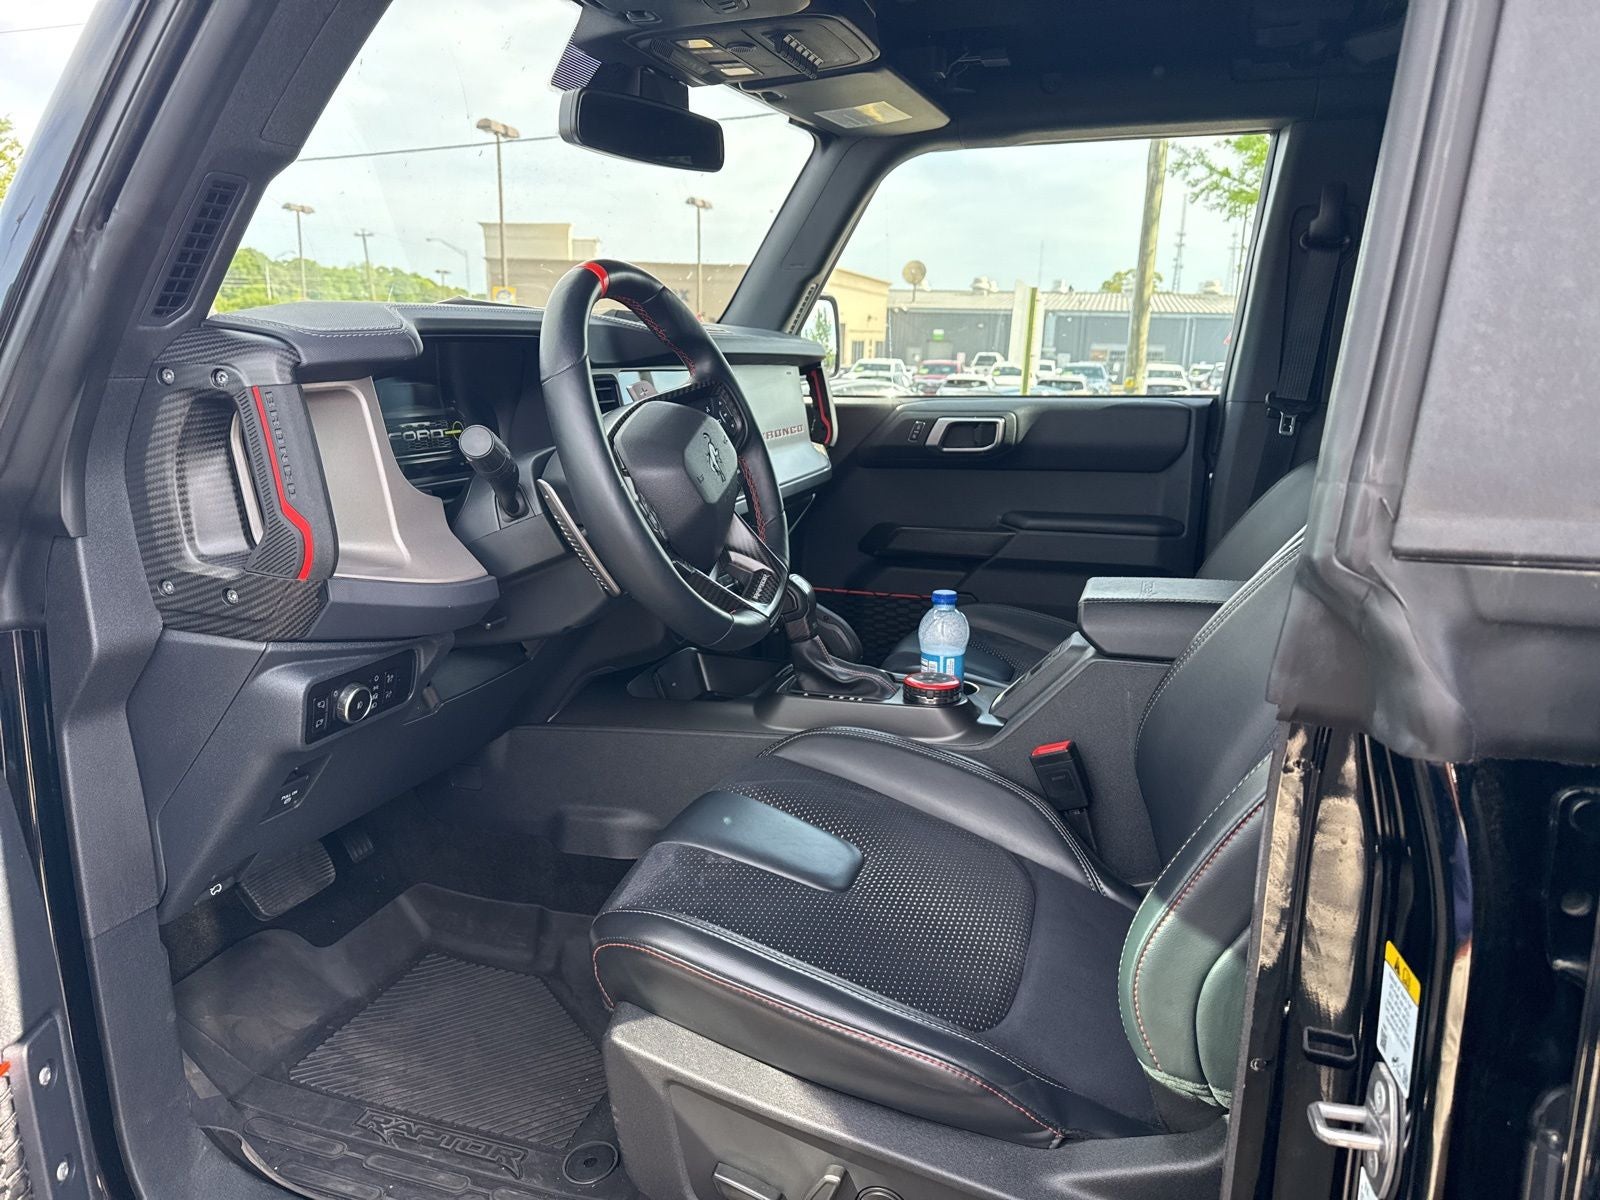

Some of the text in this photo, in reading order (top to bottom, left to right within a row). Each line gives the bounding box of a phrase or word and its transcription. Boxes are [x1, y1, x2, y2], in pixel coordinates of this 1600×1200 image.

[264, 391, 297, 497] BRONCO
[763, 424, 804, 439] RONCO
[354, 1107, 528, 1179] RAPTOR
